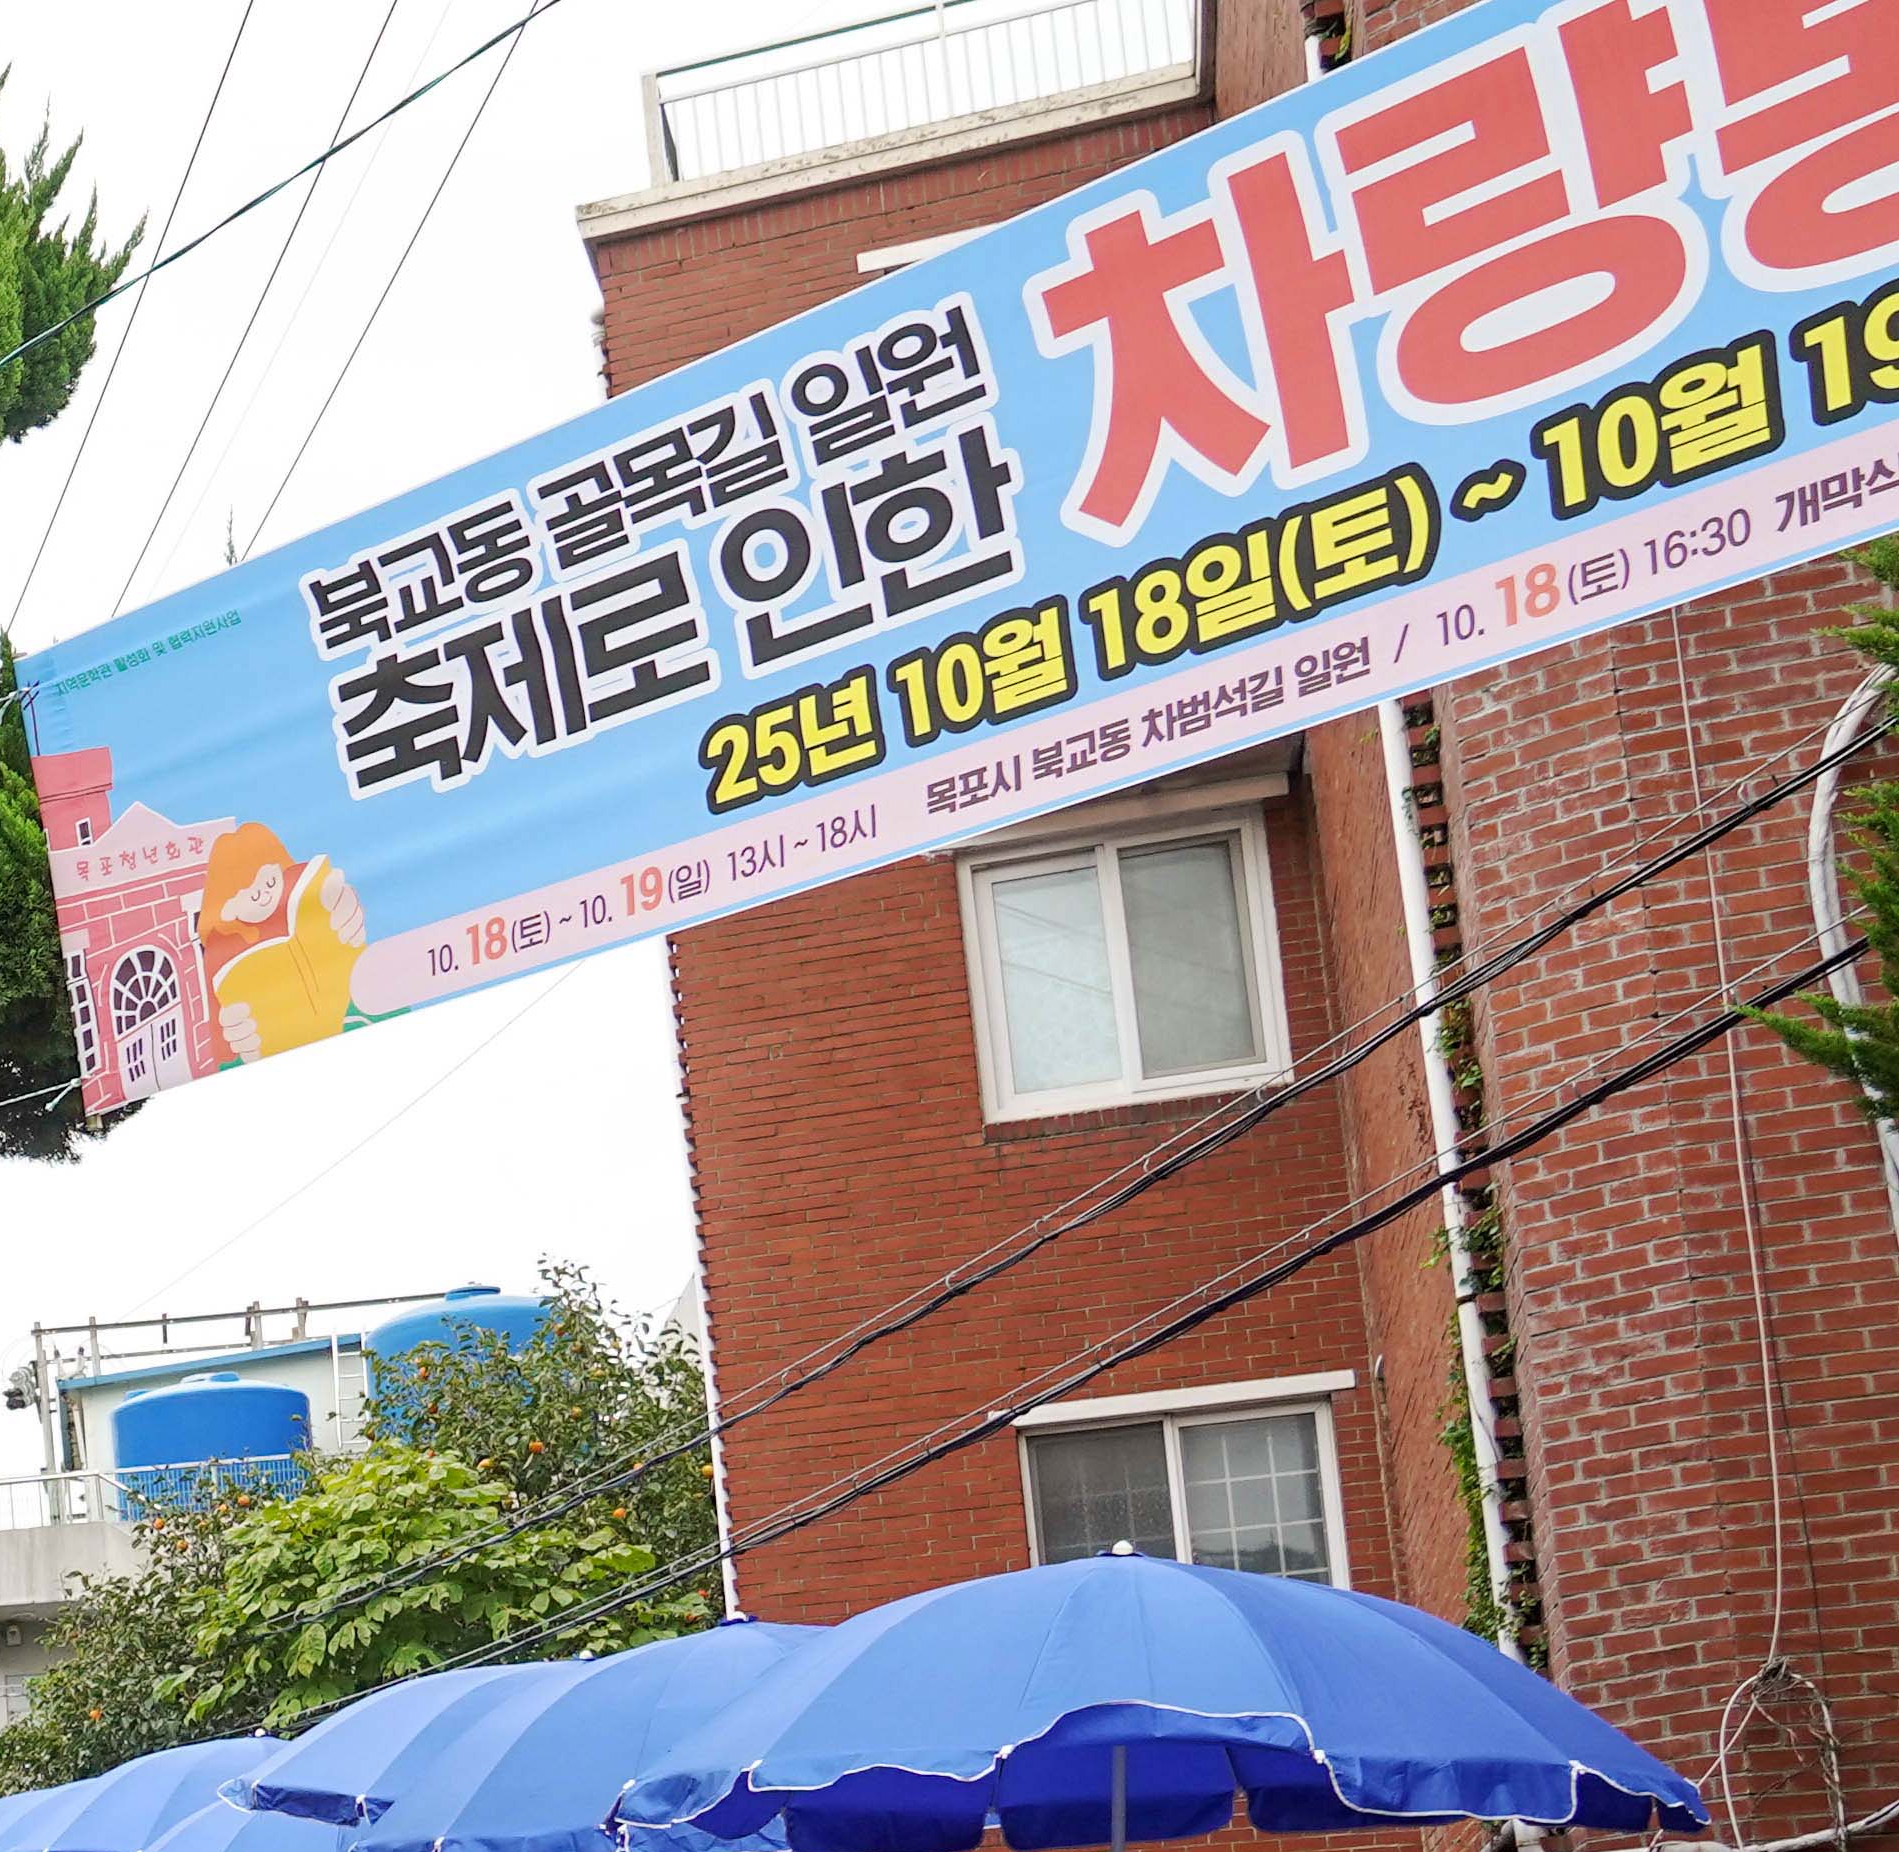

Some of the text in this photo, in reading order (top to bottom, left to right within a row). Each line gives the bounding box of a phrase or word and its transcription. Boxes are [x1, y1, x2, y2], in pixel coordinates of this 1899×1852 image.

[54, 609, 242, 697] 지역문학관 활성화 및 협력지원사업
[309, 305, 989, 651] 북교동 골목길 일원
[338, 424, 1014, 790] 축제로 인한
[707, 667, 879, 804] 25년
[894, 606, 1071, 738] 10월
[1092, 477, 1429, 670] 18일(토)
[1543, 346, 1770, 508] 10월
[76, 836, 204, 881] 목포청년회관
[427, 946, 459, 977] 10.
[578, 896, 613, 930] 10.
[727, 832, 785, 884] 13시
[816, 806, 878, 856] 18시
[927, 754, 1021, 817] 목포시
[1031, 722, 1131, 781] 북교동
[1141, 666, 1284, 751] 차범석길
[1294, 636, 1371, 697] 일원
[1437, 606, 1485, 647] 10.
[1643, 508, 1752, 578] 16:30
